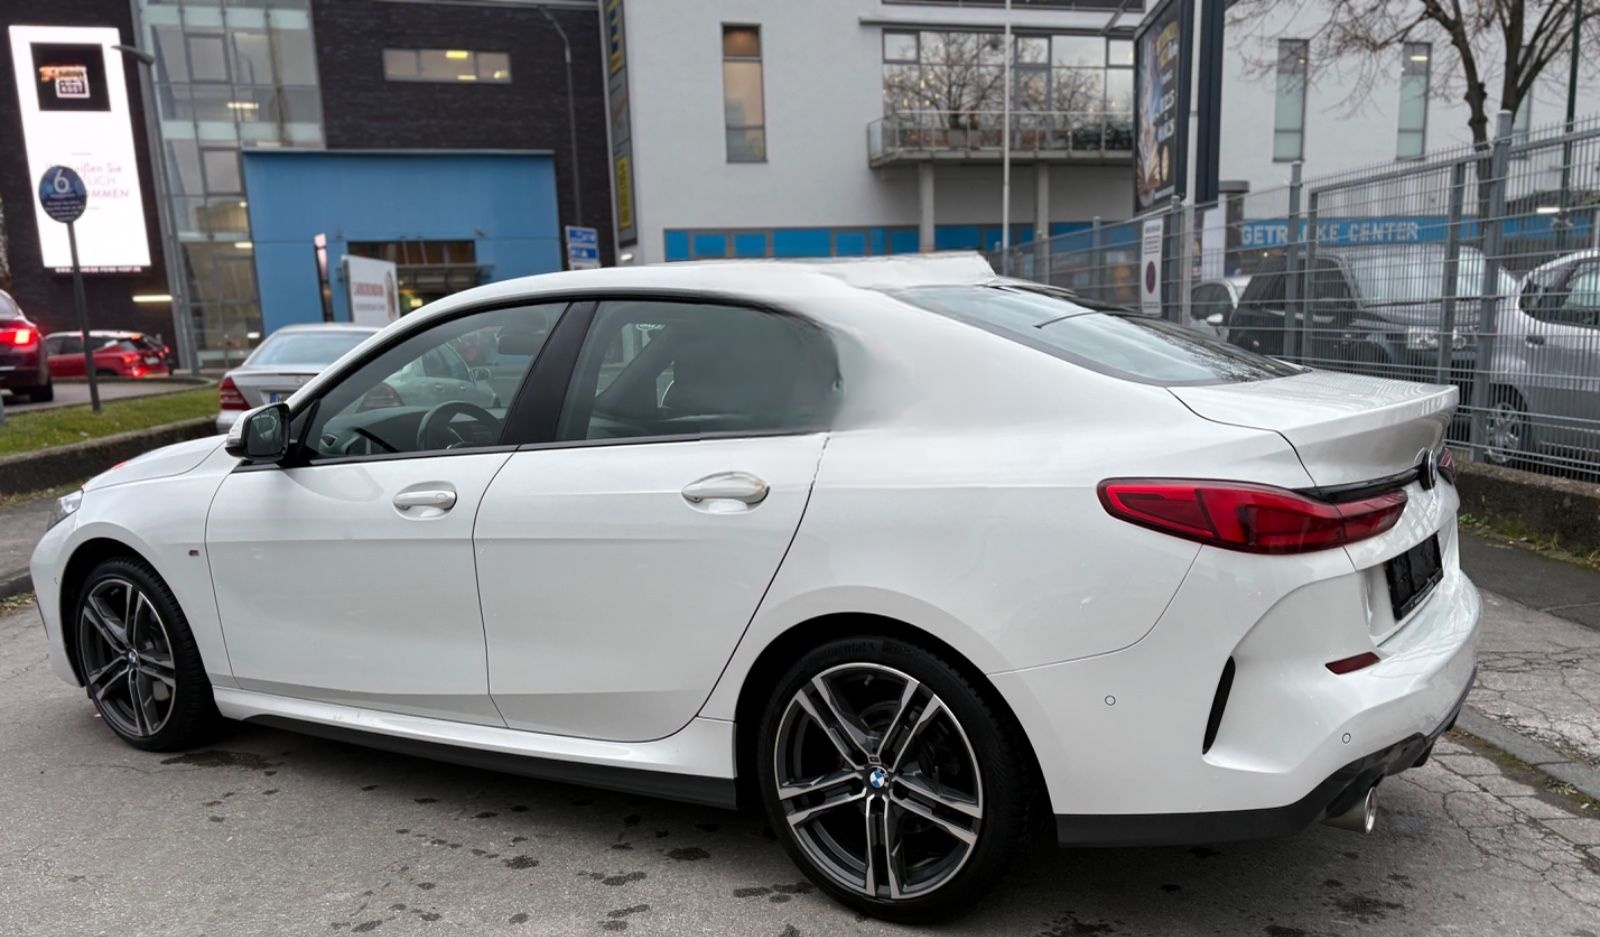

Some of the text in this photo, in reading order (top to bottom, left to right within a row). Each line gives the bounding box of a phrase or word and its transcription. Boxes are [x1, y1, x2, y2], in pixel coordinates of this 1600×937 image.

[54, 168, 69, 193] 6
[1241, 221, 1418, 245] GETRKE CENTER
